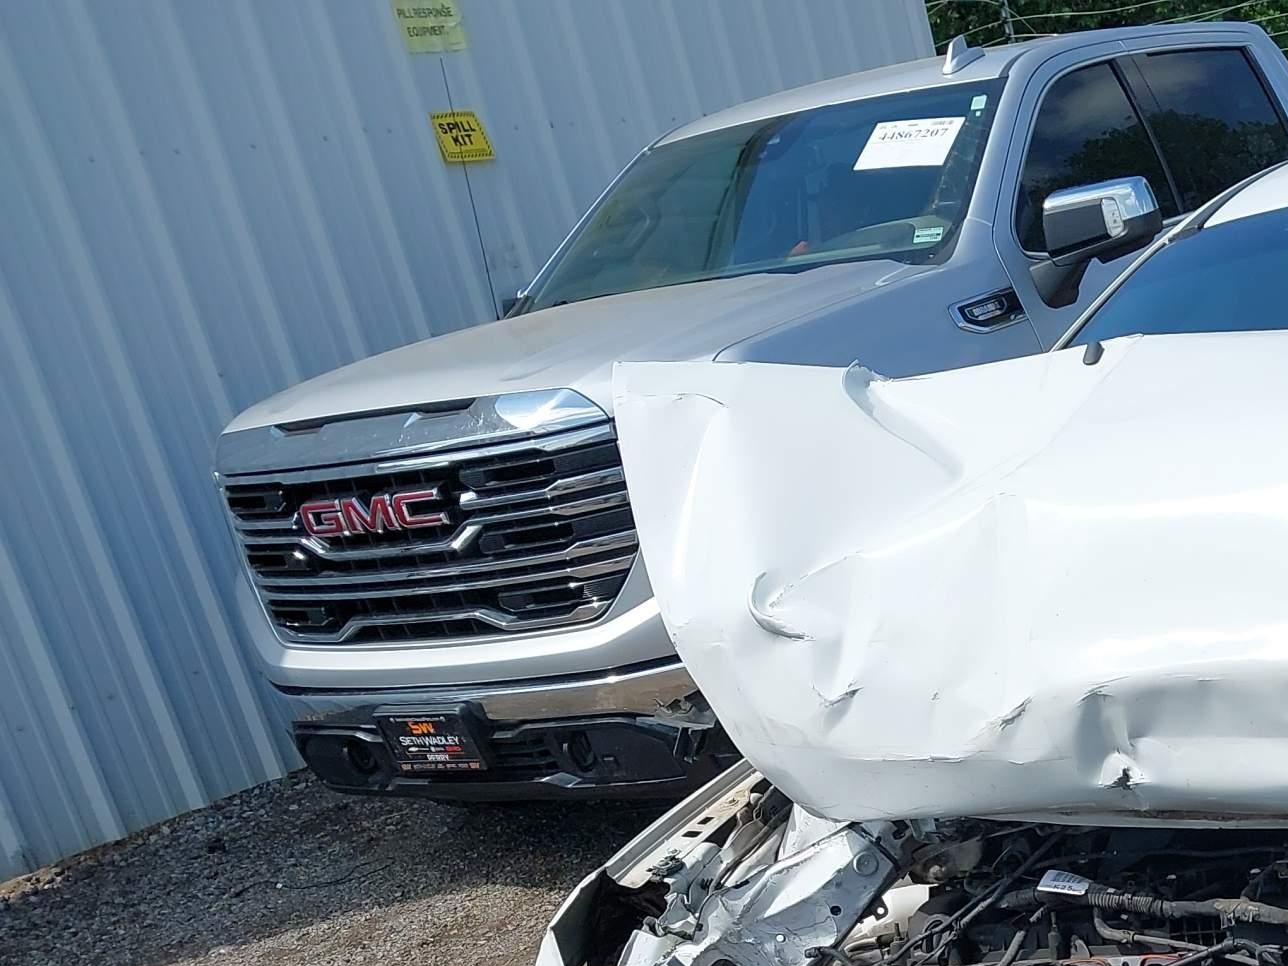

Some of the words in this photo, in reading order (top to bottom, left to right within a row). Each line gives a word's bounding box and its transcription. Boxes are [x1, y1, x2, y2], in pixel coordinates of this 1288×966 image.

[438, 121, 476, 134] SPILL
[878, 127, 949, 142] 44867207
[451, 133, 474, 147] KIT
[301, 488, 450, 537] GMC
